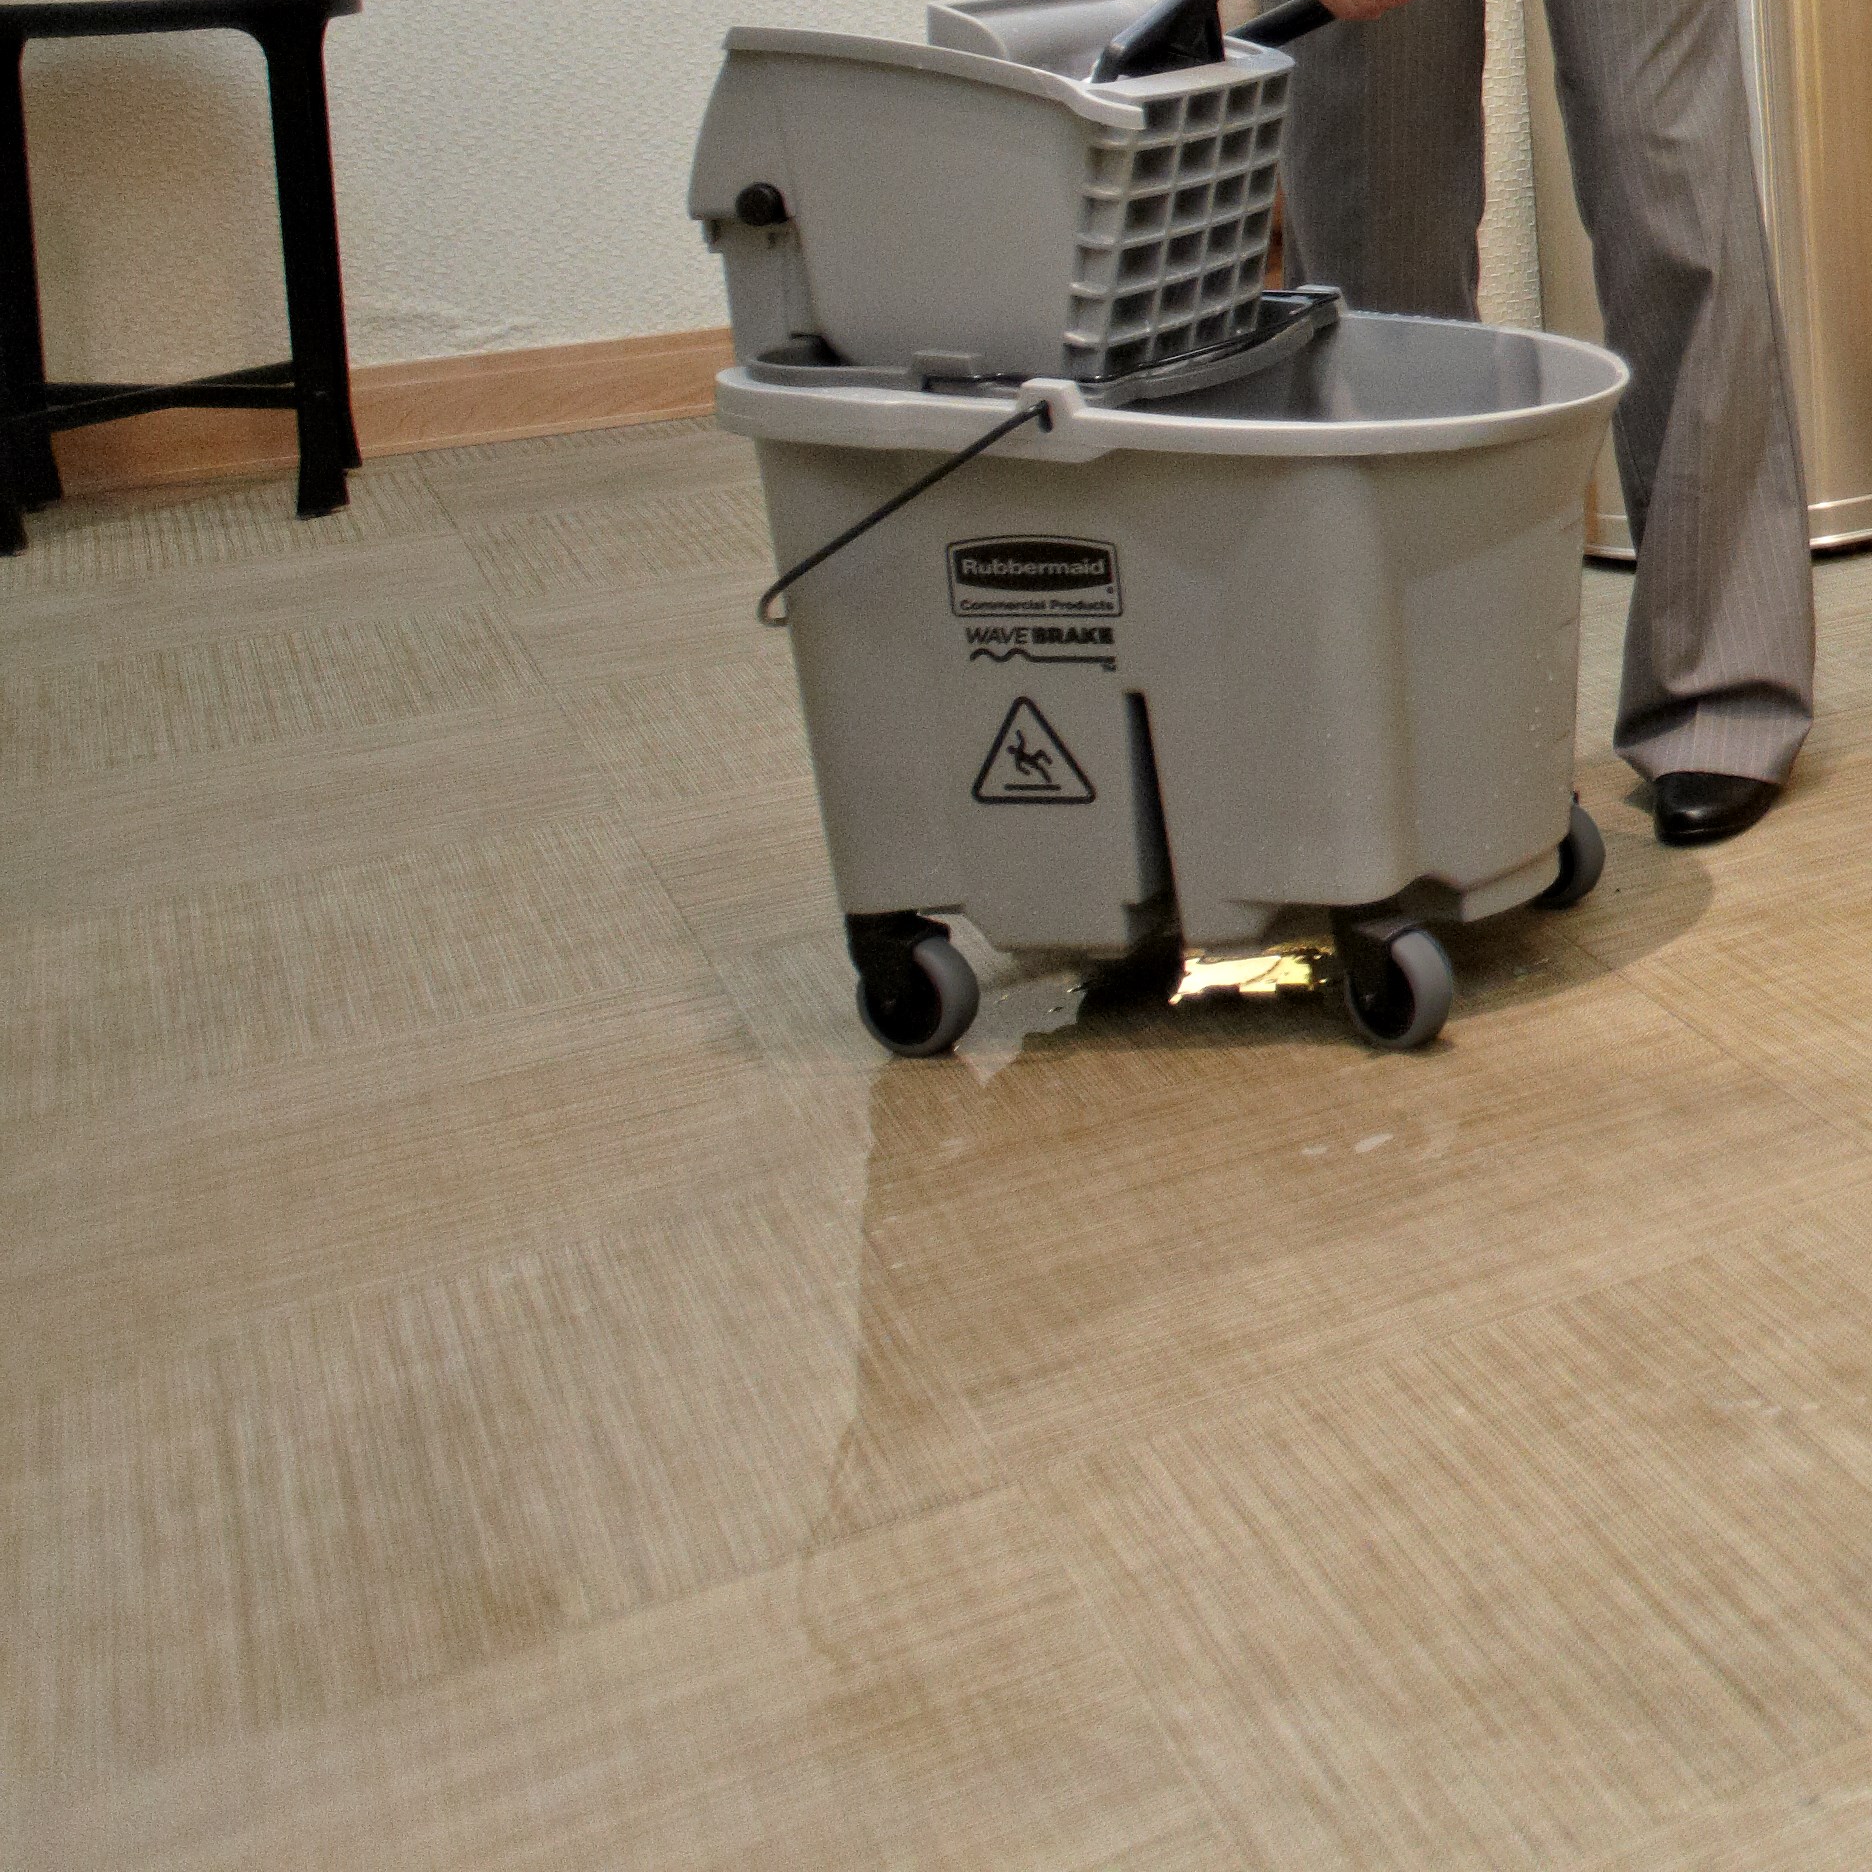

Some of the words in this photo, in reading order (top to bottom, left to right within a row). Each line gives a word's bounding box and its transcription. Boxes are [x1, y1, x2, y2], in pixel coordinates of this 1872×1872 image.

[961, 558, 1105, 576] Rubbermaid
[965, 627, 1028, 645] WAVE
[1031, 627, 1114, 645] BRAKE
